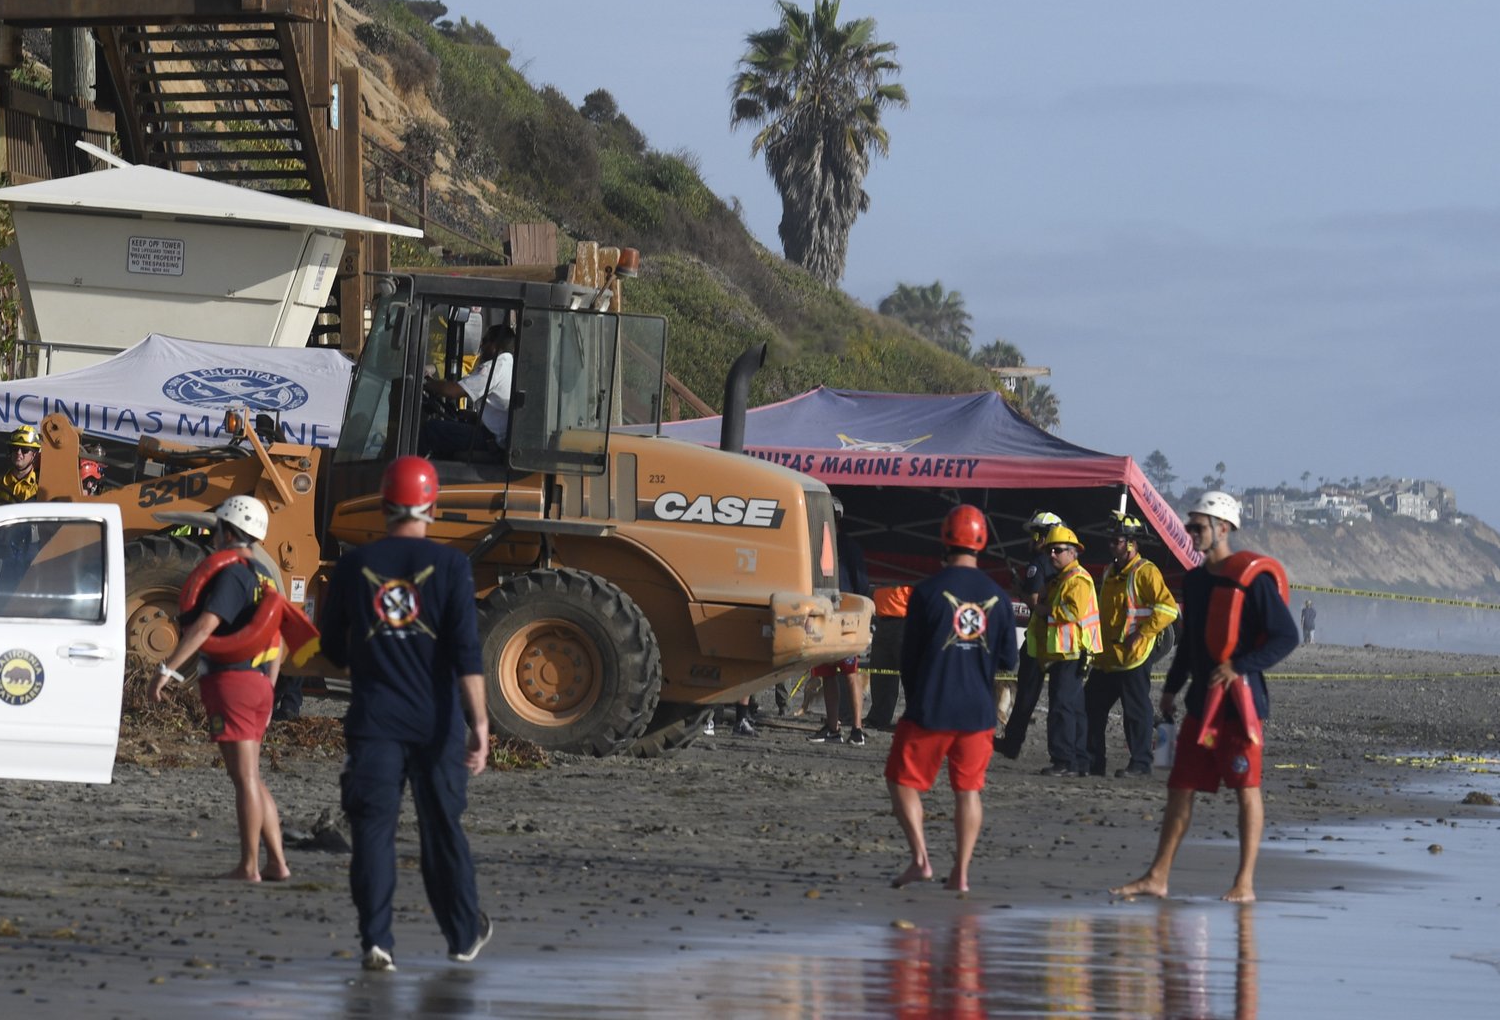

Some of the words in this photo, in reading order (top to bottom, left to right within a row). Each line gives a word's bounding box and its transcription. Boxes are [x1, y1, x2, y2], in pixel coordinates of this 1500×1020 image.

[162, 241, 181, 249] TOWER
[130, 252, 151, 260] PRIVATE
[142, 260, 179, 268] TRESPASSING
[200, 367, 281, 382] ENCINITAS
[820, 455, 903, 477] MARINE
[908, 456, 980, 479] SAFETY
[649, 474, 666, 484] 232
[138, 471, 208, 508] 521D
[653, 491, 779, 528] CASE
[19, 681, 43, 704] PARKS
